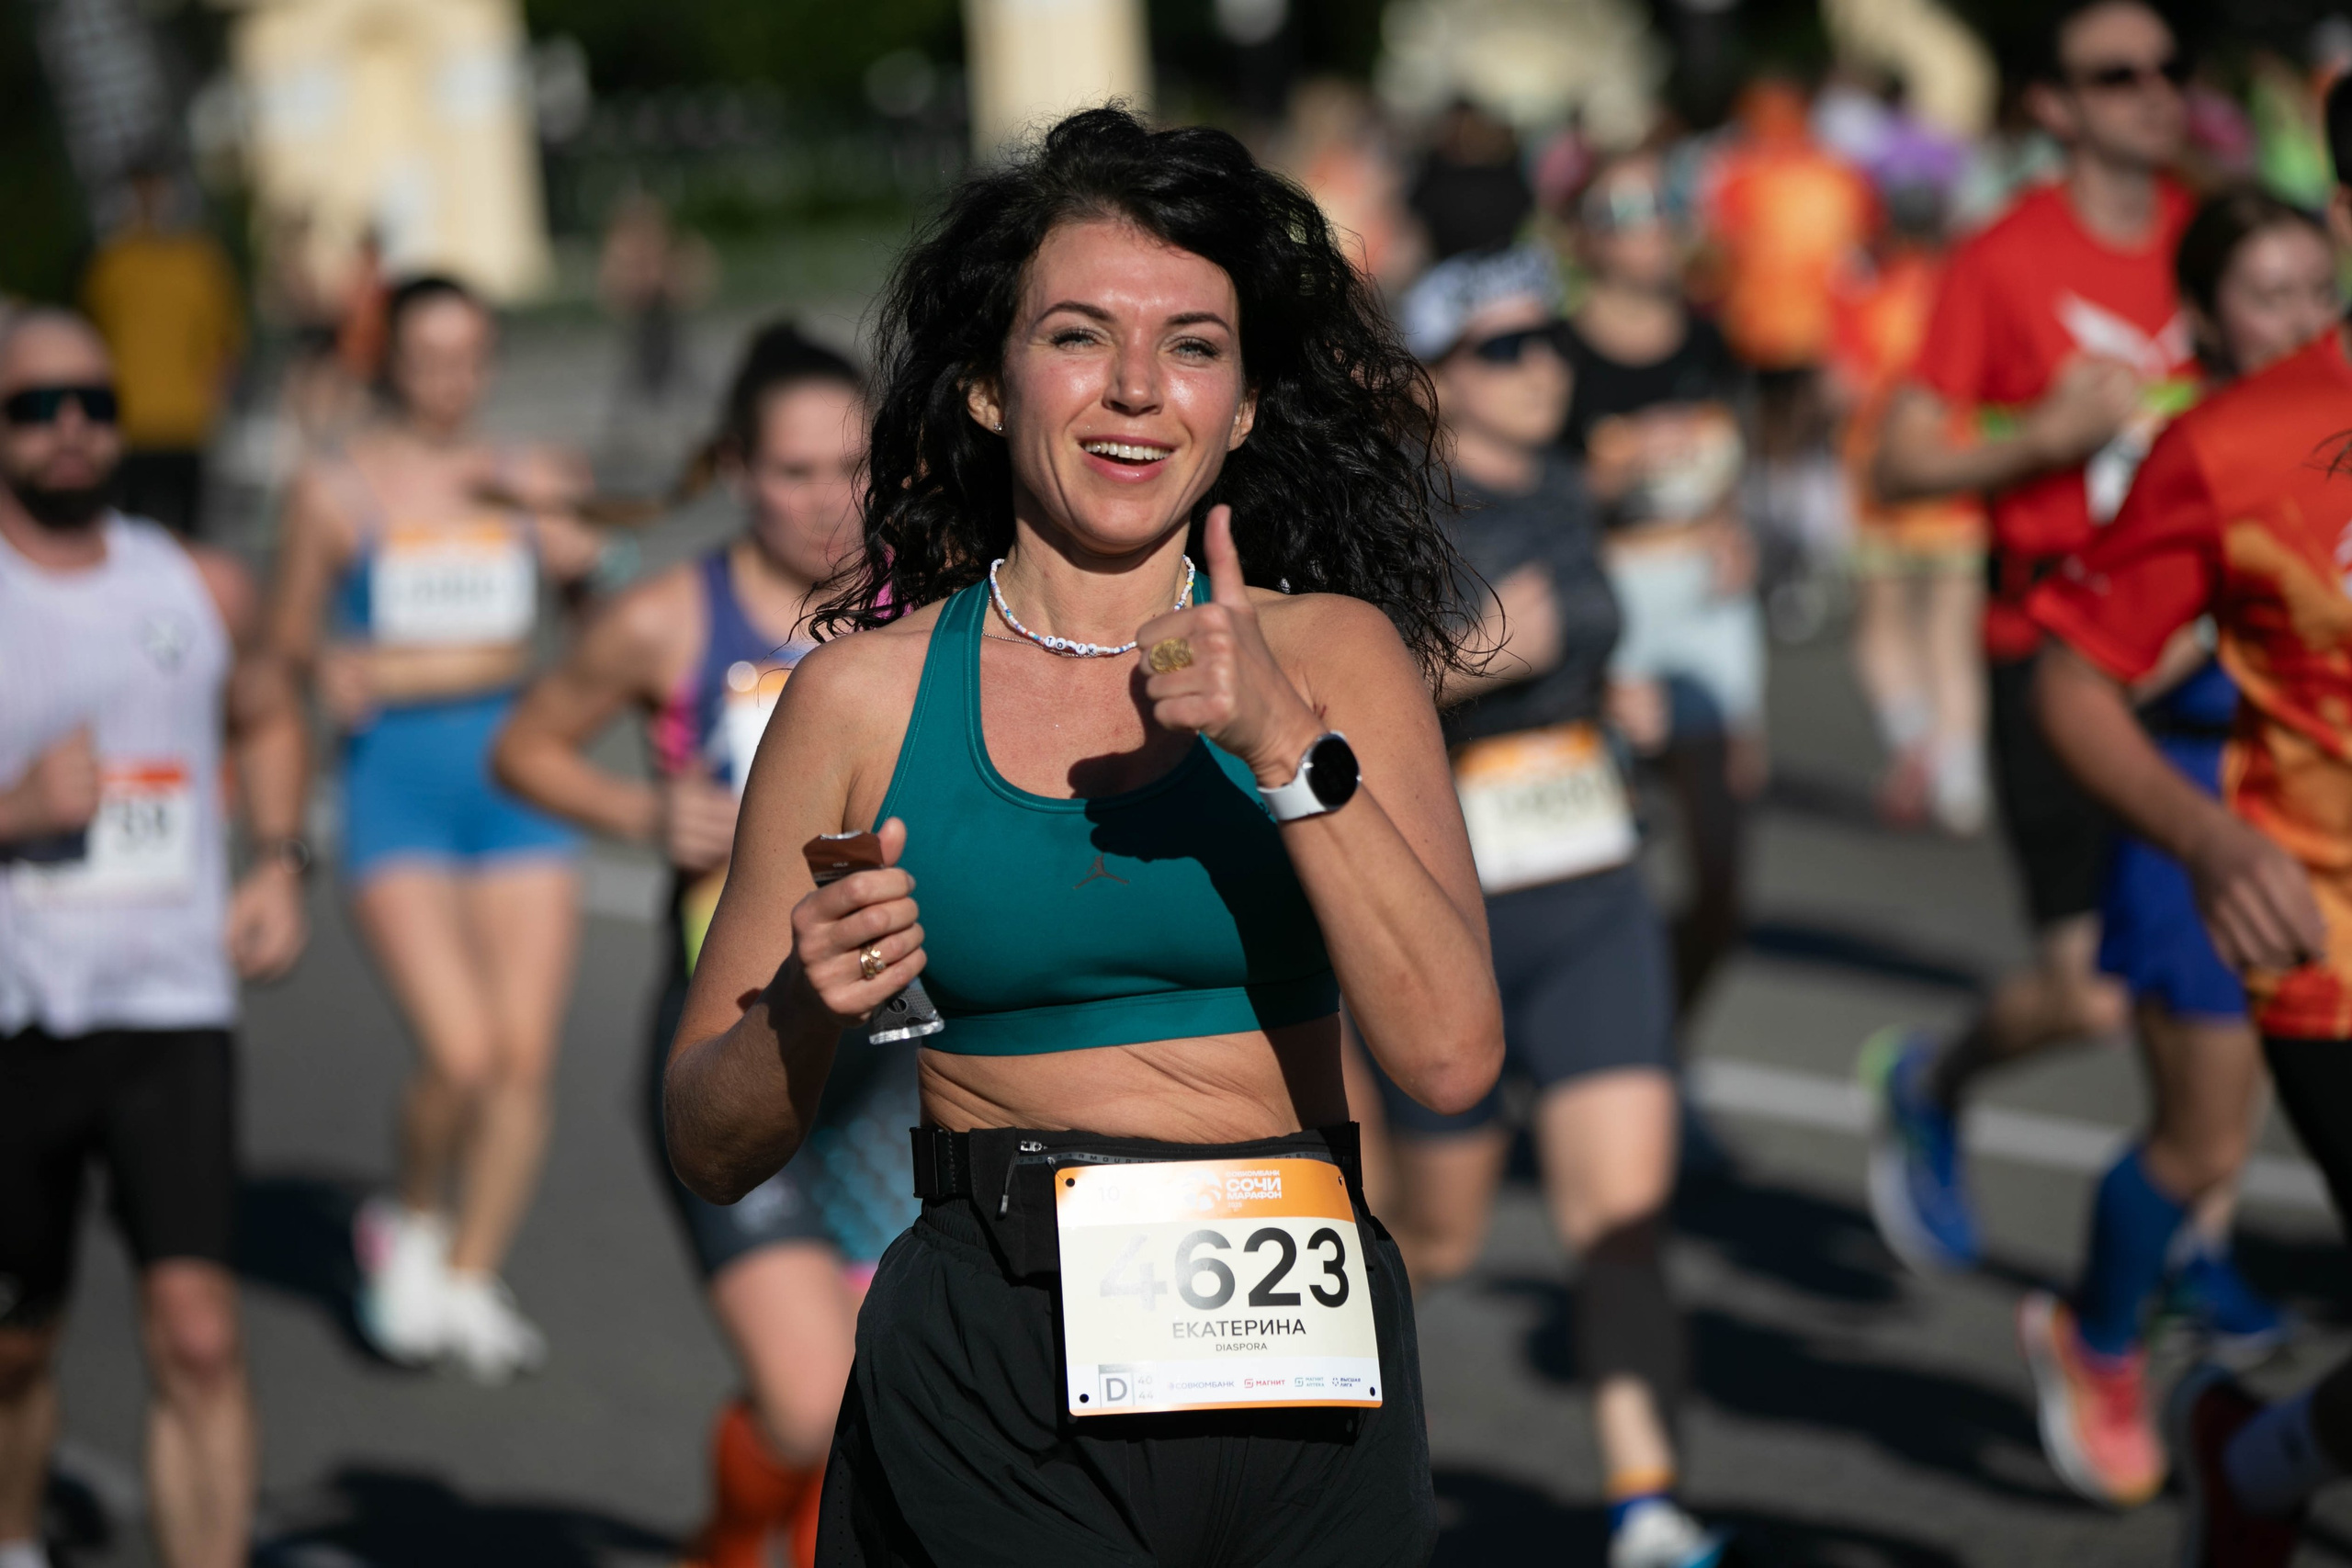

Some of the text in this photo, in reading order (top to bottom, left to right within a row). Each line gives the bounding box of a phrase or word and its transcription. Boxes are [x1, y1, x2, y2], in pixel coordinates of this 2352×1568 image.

[1047, 637, 1095, 655] TOIK
[1226, 1177, 1282, 1192] СОЧИ
[1098, 1185, 1120, 1201] 10
[1227, 1191, 1283, 1200] МАРАФОН
[1099, 1226, 1350, 1312] 4623
[1172, 1319, 1306, 1338] ЕКАТЕРИНА
[1215, 1342, 1268, 1352] DIASPORA
[1137, 1375, 1153, 1385] 40
[1175, 1381, 1235, 1390] СОВКОМБАНК
[1105, 1377, 1127, 1402] D
[1138, 1391, 1154, 1400] 44
